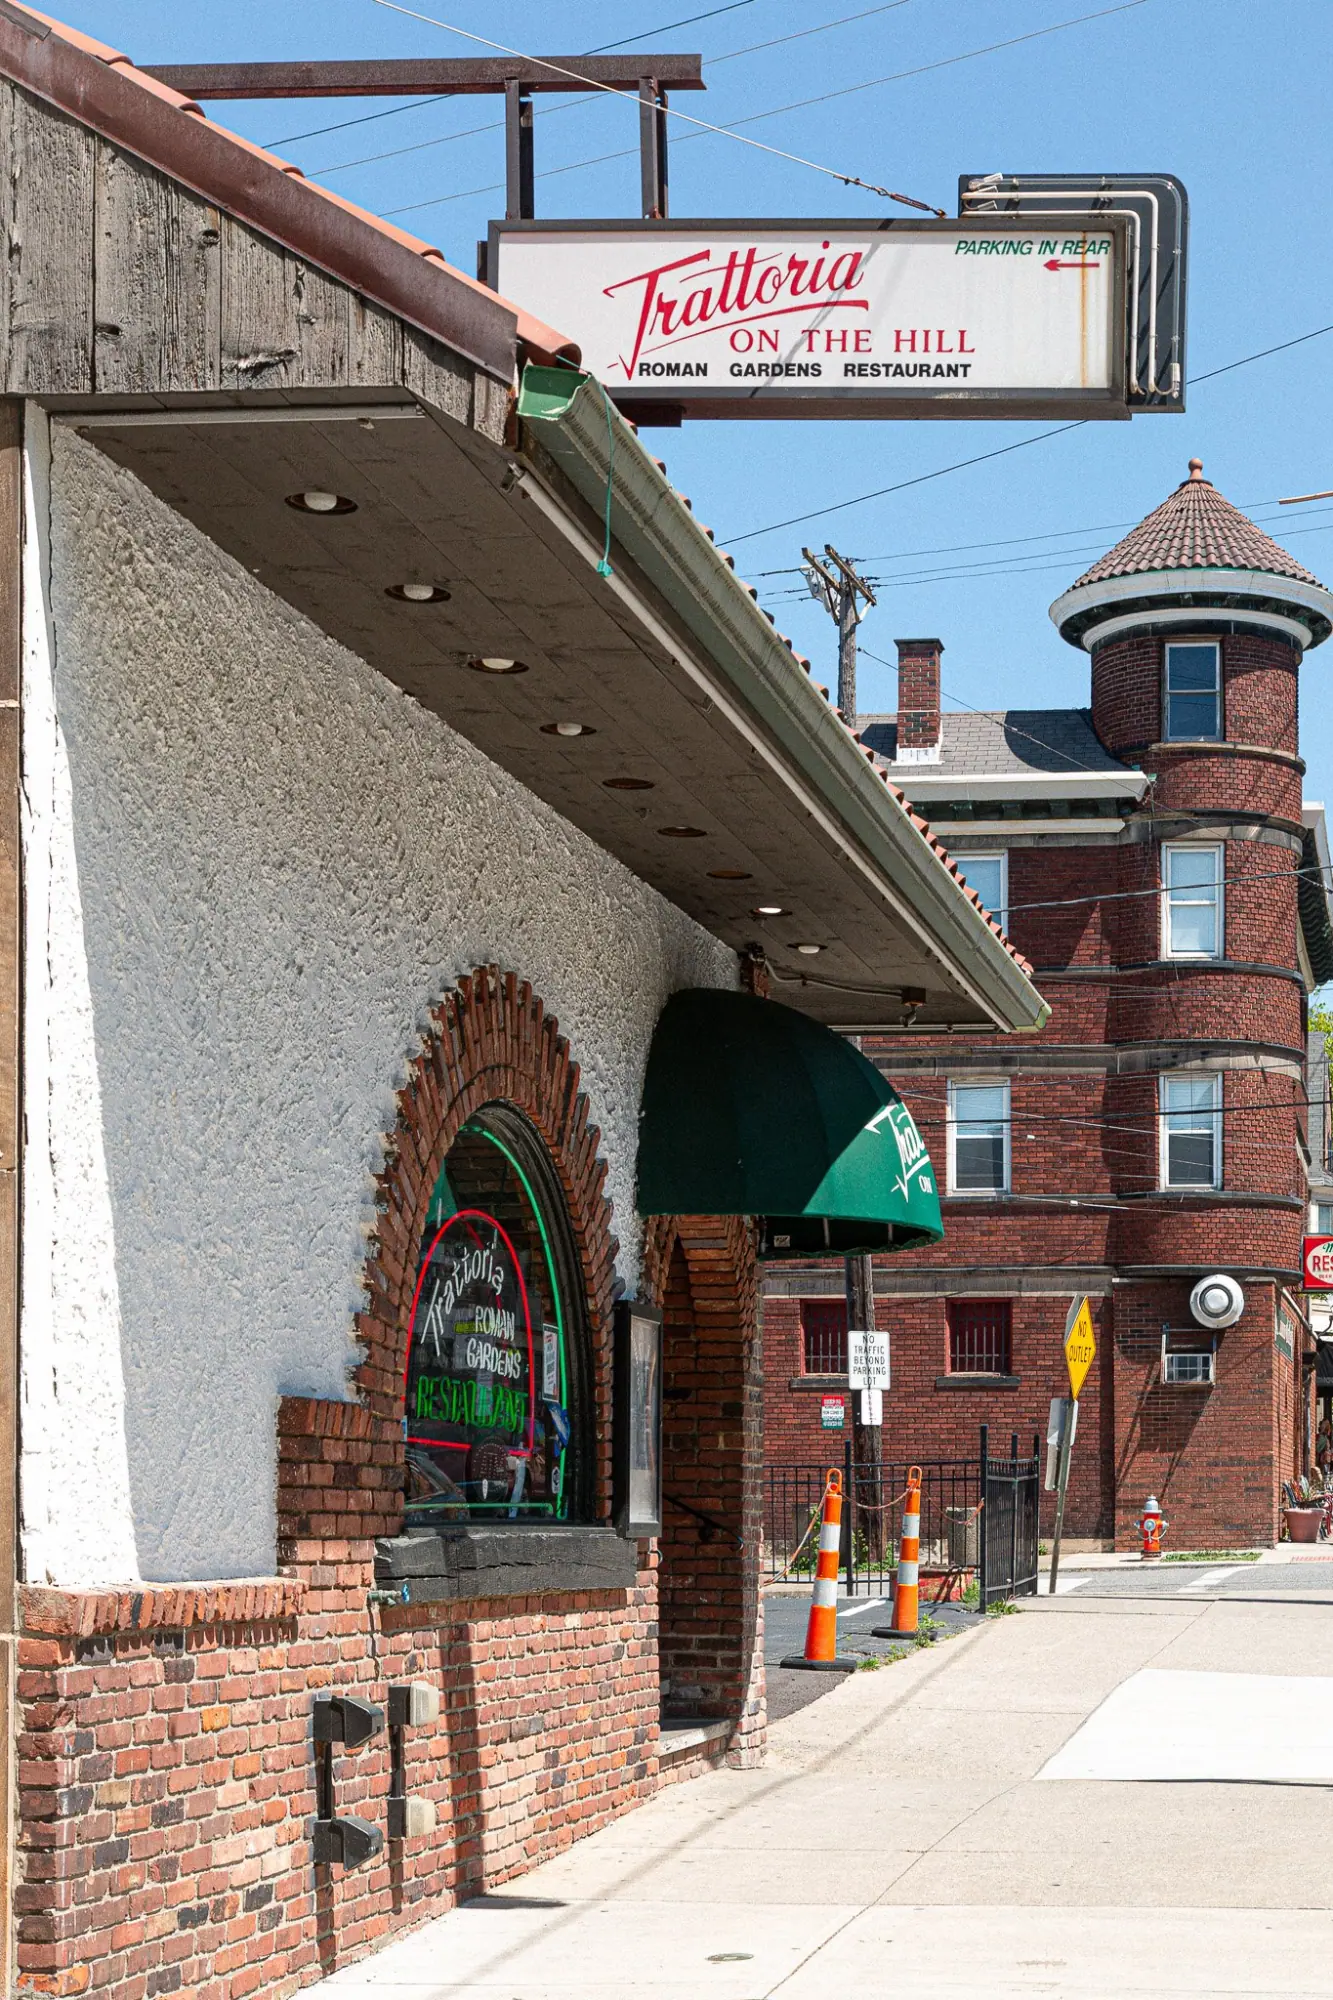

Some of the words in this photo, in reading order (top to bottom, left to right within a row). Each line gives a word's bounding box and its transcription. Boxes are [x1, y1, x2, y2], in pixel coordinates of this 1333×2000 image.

[954, 240, 1033, 256] PARKING
[1037, 240, 1057, 255] IN
[1060, 240, 1112, 256] REAR
[602, 240, 869, 381] Trattoria
[729, 329, 780, 353] ON
[801, 329, 873, 353] THE
[893, 329, 976, 353] HILL
[638, 362, 708, 377] ROMAN
[729, 362, 823, 378] GARDENS
[843, 362, 972, 378] RESTAURANT
[420, 1244, 504, 1357] Trattoria
[475, 1305, 515, 1342] ROMAN
[1077, 1320, 1088, 1338] NO
[862, 1335, 875, 1344] NO
[466, 1337, 521, 1379] GARDENS
[854, 1345, 885, 1355] TRAFFIC
[1068, 1345, 1092, 1363] OUTLET
[853, 1355, 886, 1365] BEYOND
[853, 1366, 887, 1376] PARKING
[863, 1376, 877, 1386] LOT
[416, 1375, 529, 1434] RESTAURANT
